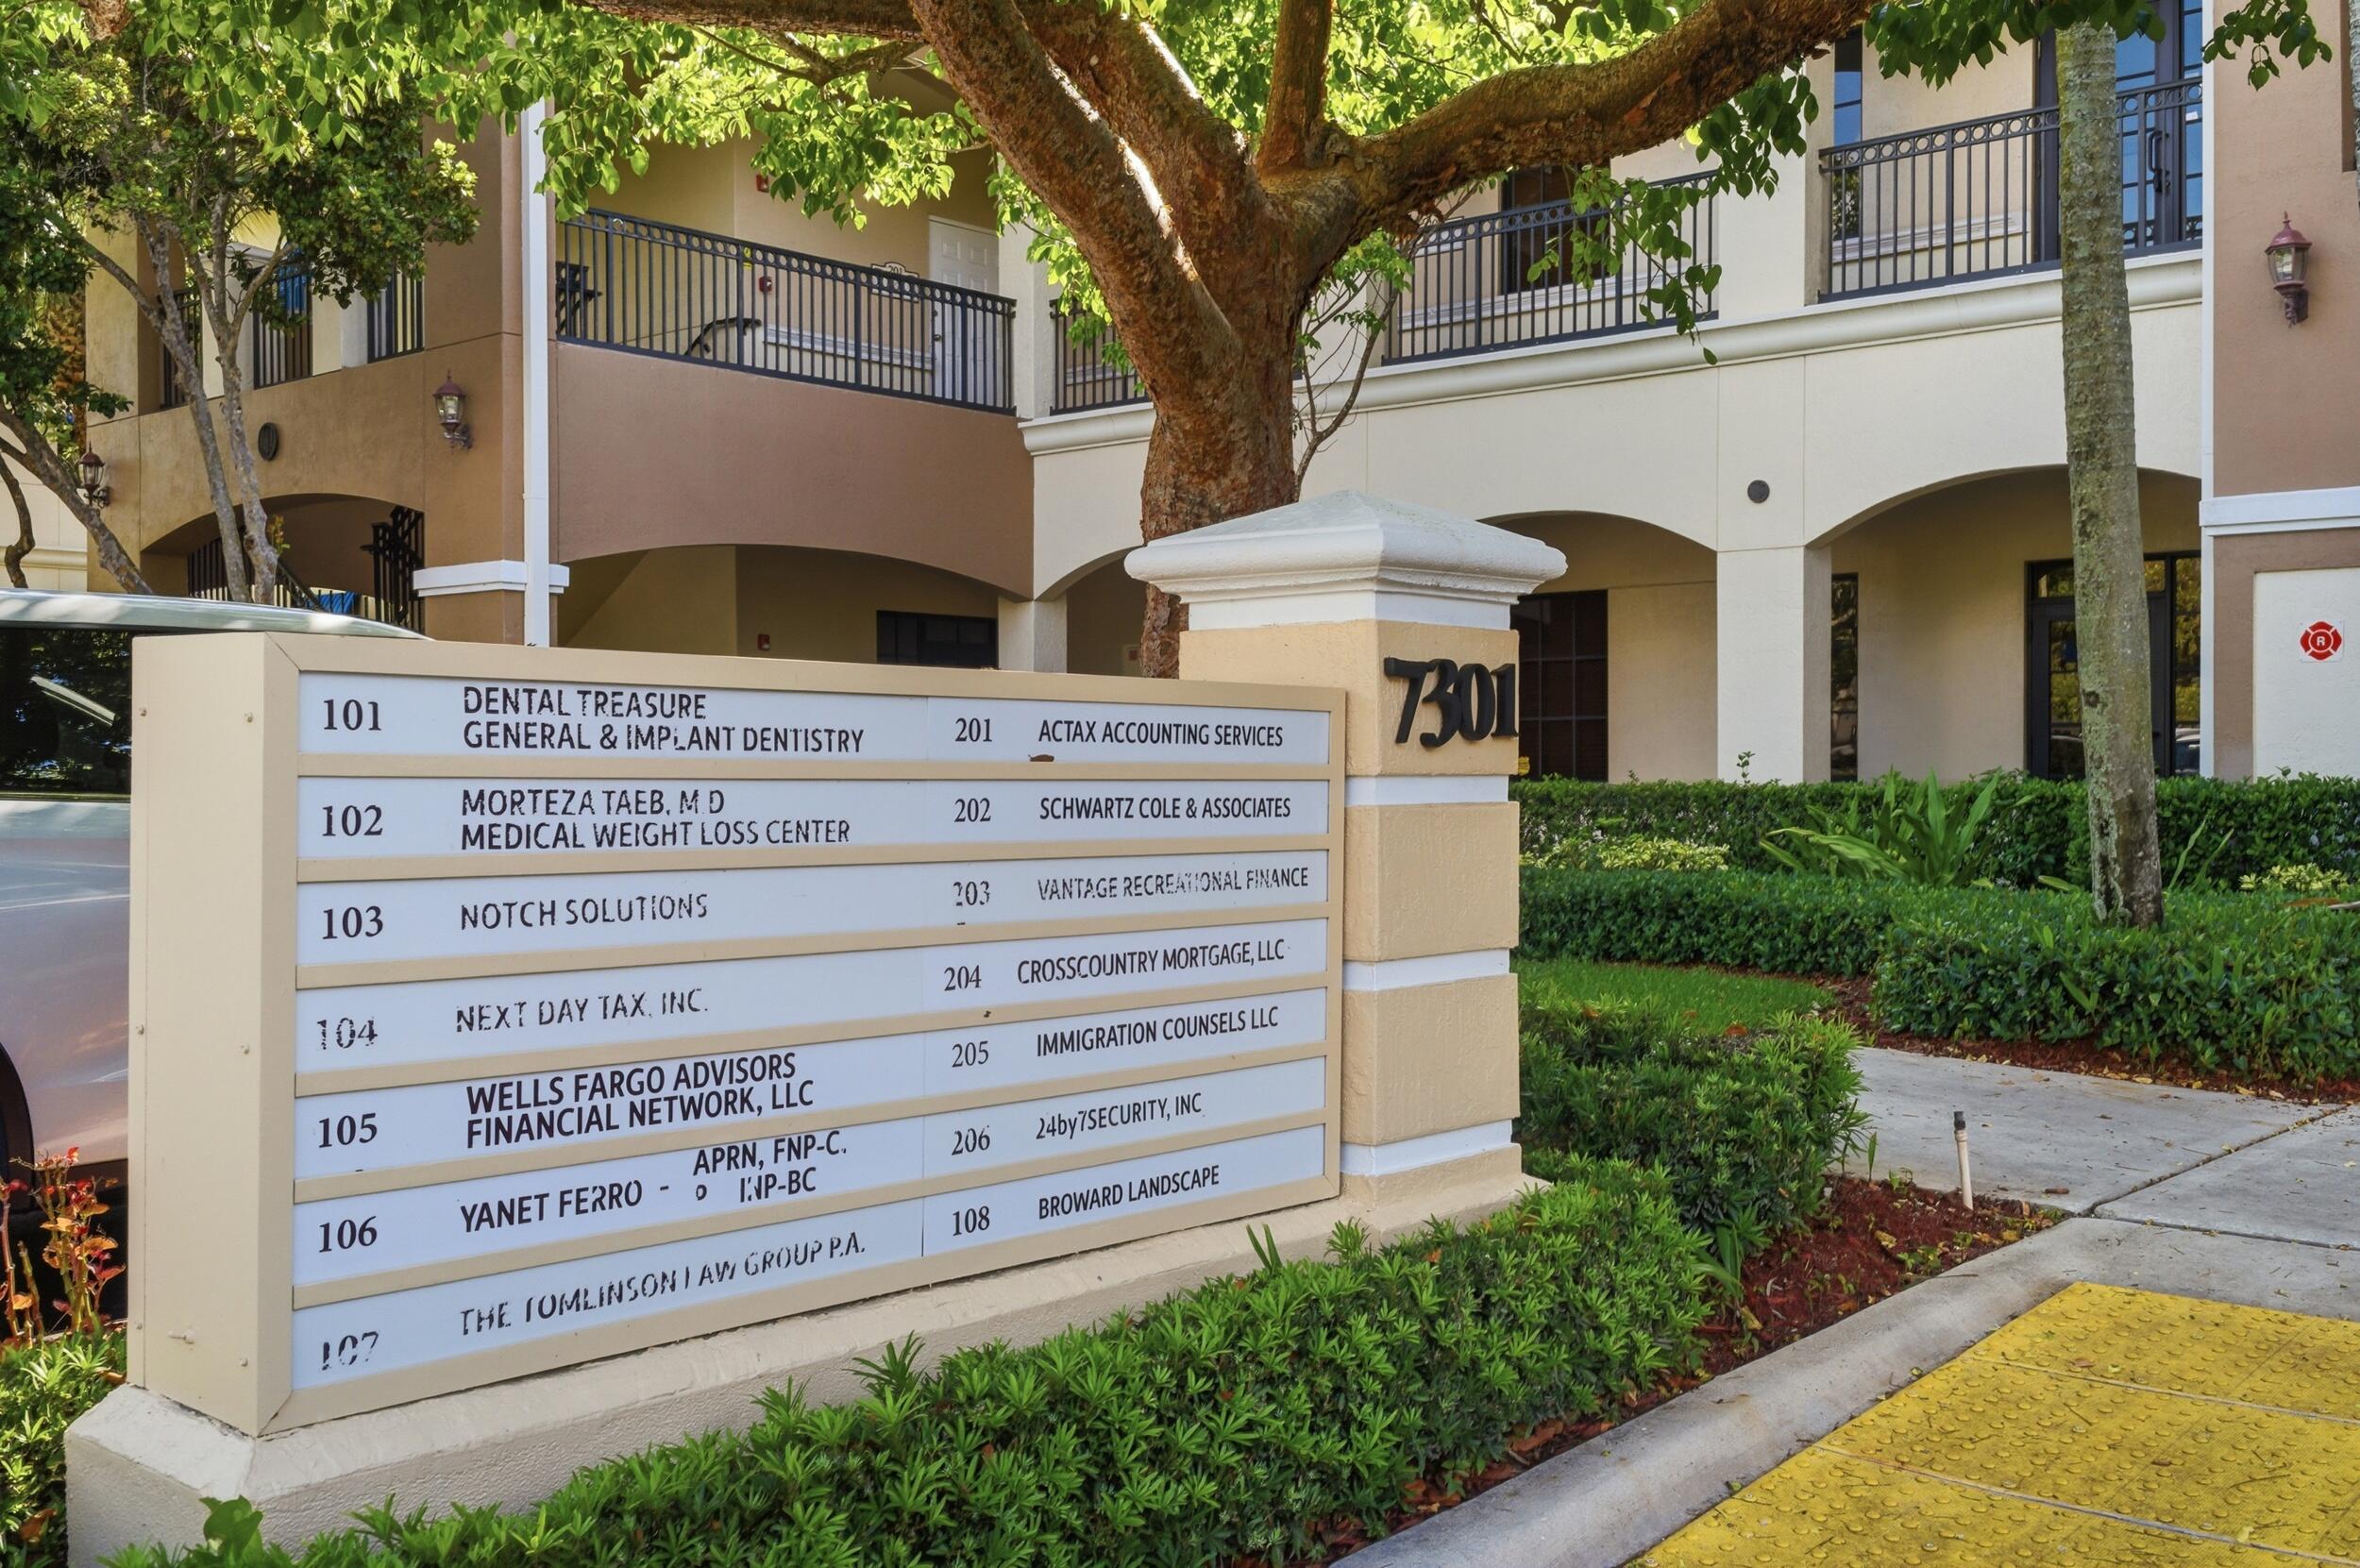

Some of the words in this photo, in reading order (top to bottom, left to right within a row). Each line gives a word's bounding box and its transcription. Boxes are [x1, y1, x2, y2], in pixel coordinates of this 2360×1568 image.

[324, 700, 381, 731] 101
[464, 686, 571, 716] DENTAL
[577, 690, 706, 719] TREASURE
[1384, 657, 1518, 747] 7301
[464, 721, 591, 749] GENERAL
[600, 724, 617, 750] &
[744, 727, 864, 752] DENTISTRY
[955, 717, 992, 742] 201
[1038, 720, 1096, 742] ACTAX
[1102, 721, 1208, 745] ACCOUNTING
[1214, 725, 1283, 747] SERVICES
[463, 789, 595, 816] MORTEZA
[954, 798, 991, 822] 202
[1040, 798, 1134, 819] SCHWARTZ
[1139, 798, 1180, 818] COLE
[1186, 798, 1197, 818] &
[1202, 798, 1290, 818] ASSOCIATES
[323, 805, 382, 836] 102
[462, 822, 585, 850] MEDICAL
[593, 821, 693, 848] WEIGHT
[701, 821, 758, 845] LOSS
[767, 819, 850, 844] CENTER
[953, 881, 989, 906] 203
[1038, 877, 1117, 900] VANTAGE
[1247, 868, 1307, 889] FINANCE
[323, 906, 383, 939] 103
[462, 901, 555, 930] NOTCH
[565, 894, 707, 924] SOLUTIONS
[1018, 950, 1158, 984] CROSSCOUNTRY
[1163, 942, 1254, 970] MORTGAGE,
[1258, 939, 1284, 961] LLC
[944, 965, 981, 991] 204
[457, 1002, 527, 1032] NEXT
[539, 999, 588, 1025] DAY
[1037, 1020, 1156, 1056] IMMIGRATION
[1163, 1010, 1245, 1040] COUNSELS
[1252, 1006, 1278, 1029] LLC
[317, 1018, 378, 1050] 104
[952, 1041, 988, 1068] 205
[466, 1076, 564, 1114] WELLS
[575, 1066, 665, 1103] FARGO
[673, 1053, 798, 1091] ADVISORS
[467, 1104, 619, 1148] FINANCIAL
[630, 1087, 762, 1127] NETWORK,
[772, 1080, 813, 1109] LLC
[1037, 1098, 1170, 1139] 24by7SECURITY,
[319, 1113, 377, 1148] 105
[952, 1128, 990, 1155] 206
[693, 1142, 764, 1176] APRN,
[461, 1193, 549, 1232] YANET
[559, 1180, 642, 1217] FERRO
[1039, 1184, 1122, 1220] BROWARD
[1129, 1165, 1219, 1202] LANDSCAPE
[319, 1216, 377, 1253] 106
[952, 1206, 989, 1236] 108
[461, 1302, 511, 1335] THE
[745, 1240, 822, 1275] GROUP
[830, 1232, 865, 1258] P.A.
